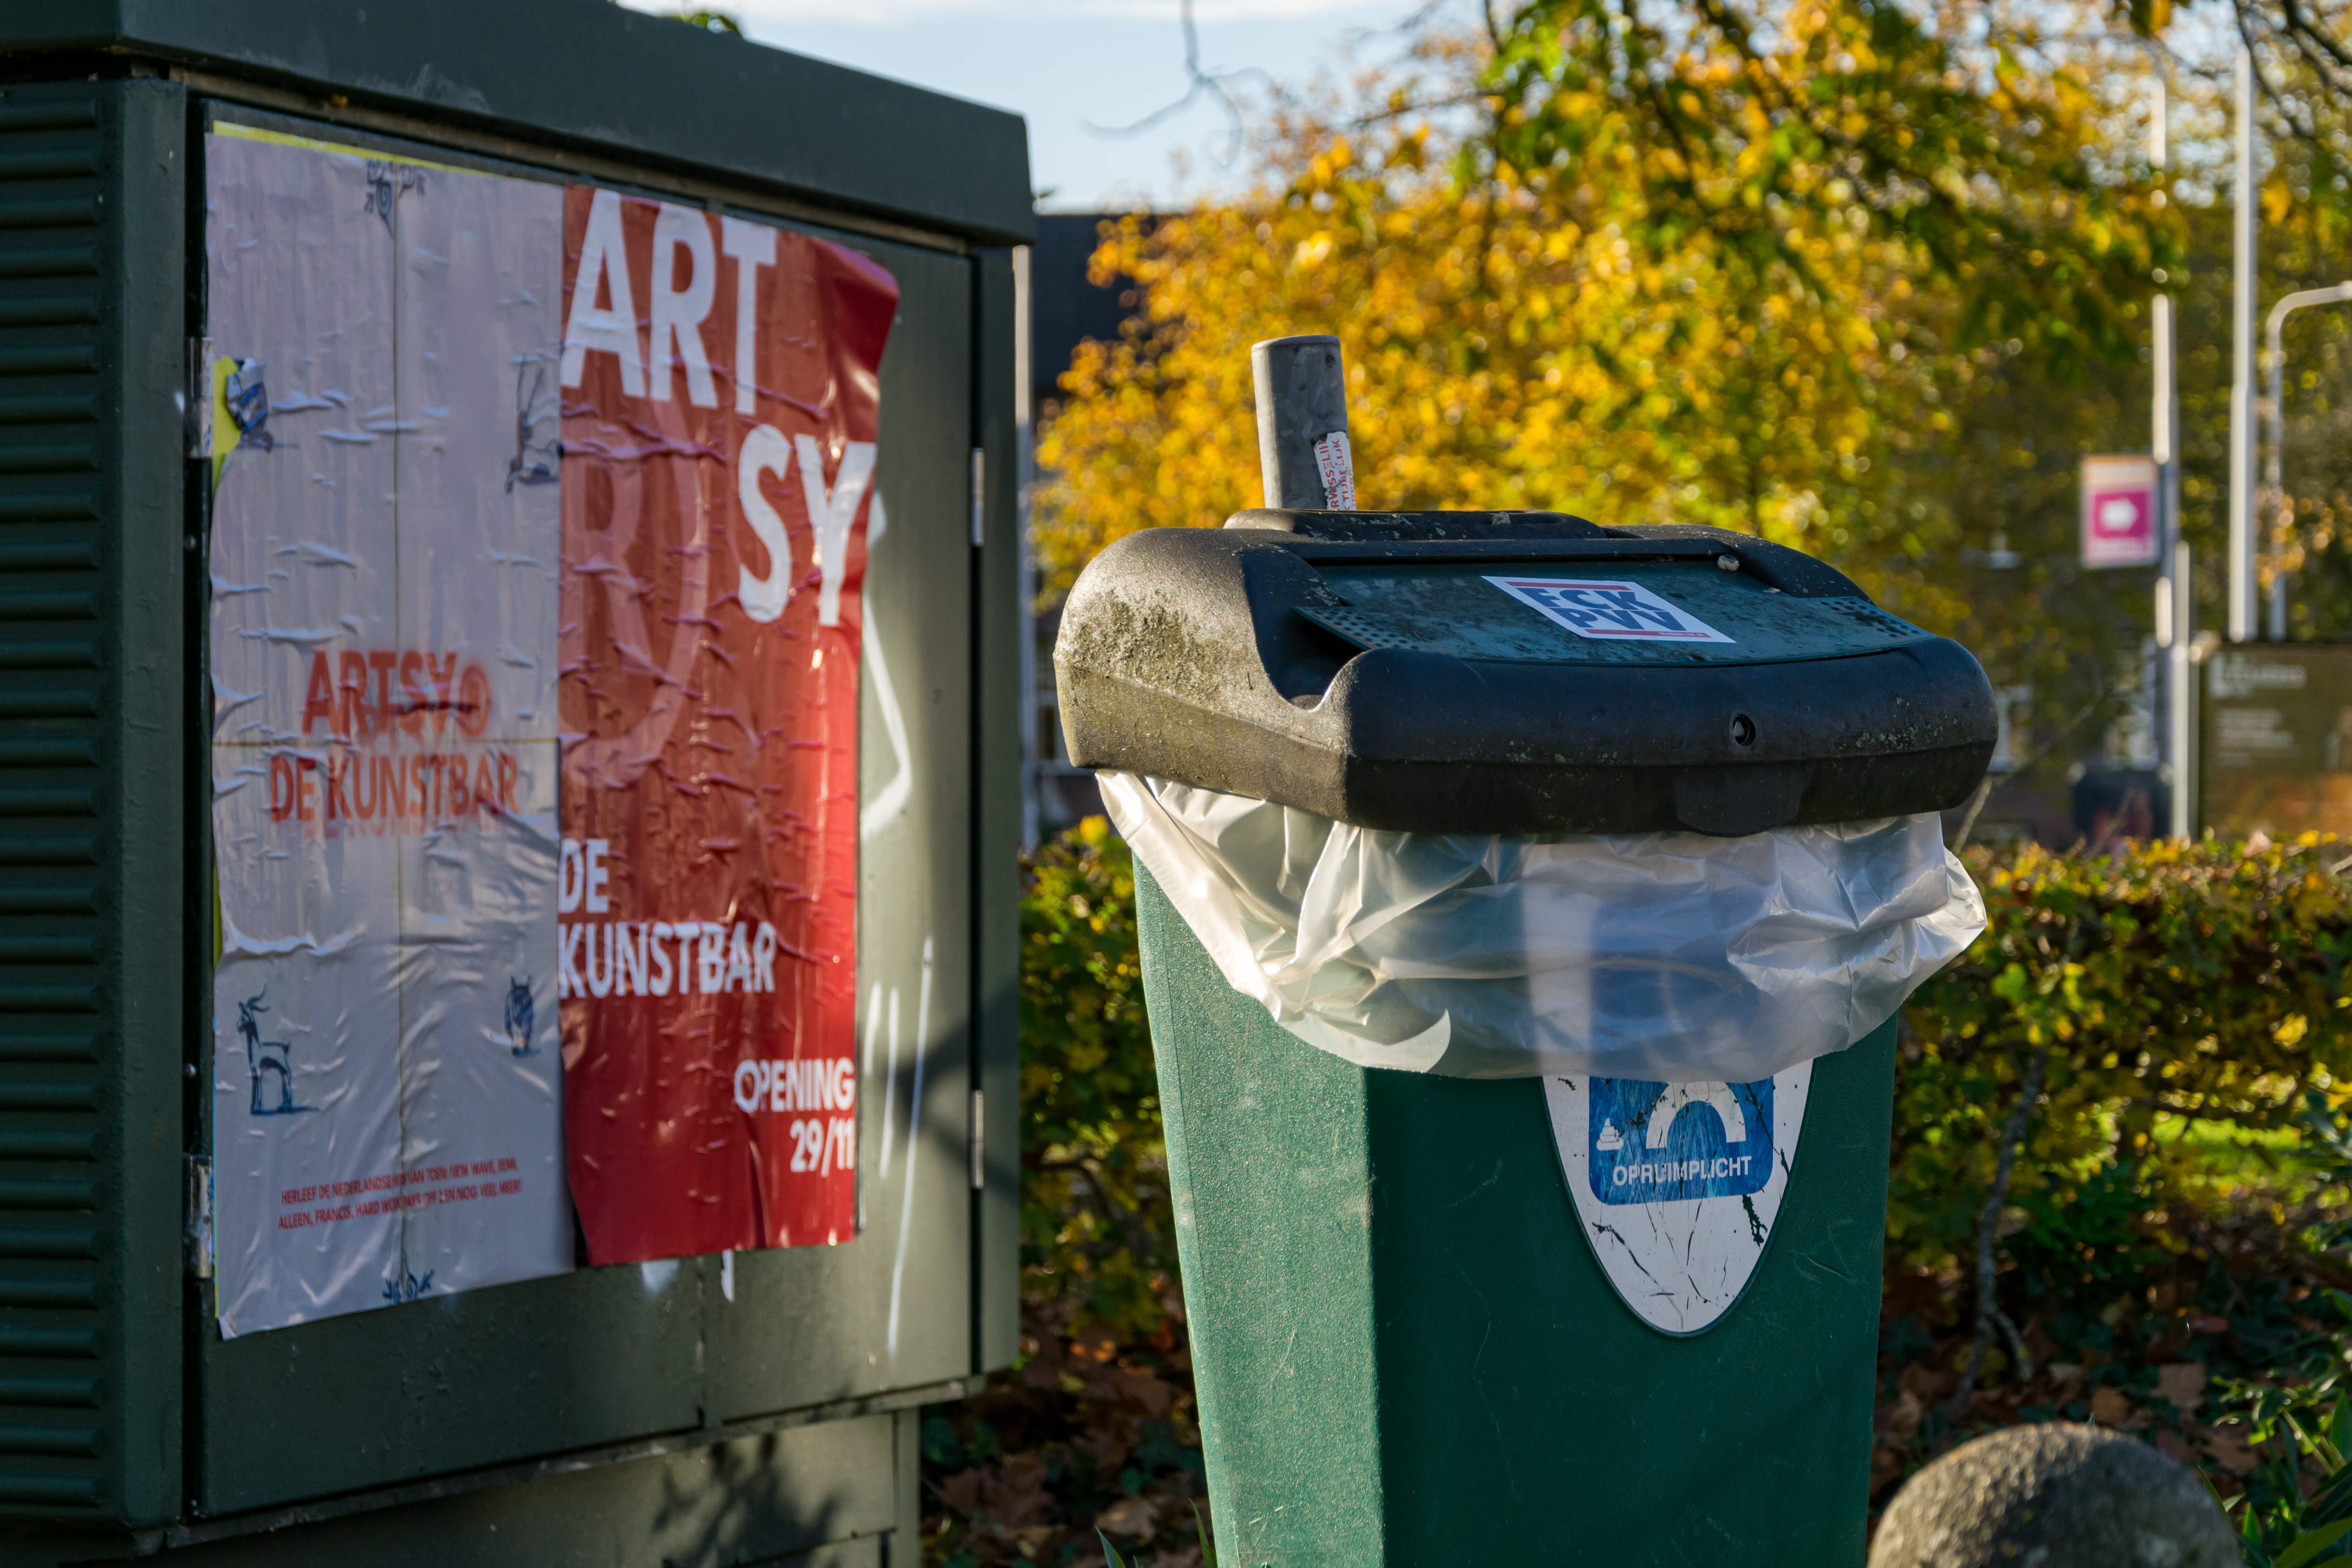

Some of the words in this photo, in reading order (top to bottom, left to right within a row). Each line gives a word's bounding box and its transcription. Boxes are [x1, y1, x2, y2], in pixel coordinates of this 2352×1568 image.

[561, 187, 776, 415] ART
[739, 424, 876, 627] SY
[1515, 587, 1667, 611] FCK
[1548, 607, 1688, 632] PVV
[270, 755, 316, 823] DE
[327, 752, 519, 822] KUNSTBAR
[557, 838, 609, 913] DE
[557, 921, 776, 999] KUNSTBAR
[733, 1057, 856, 1114] OPENING
[789, 1116, 855, 1178] 29/11
[1612, 1155, 1752, 1186] OPRUIMPLICHT
[281, 1185, 317, 1205] HERLEEF
[318, 1183, 331, 1200] DE
[332, 1174, 392, 1197] NEDERLANDSE
[407, 1169, 424, 1184] VAN
[355, 1200, 379, 1217] HARD
